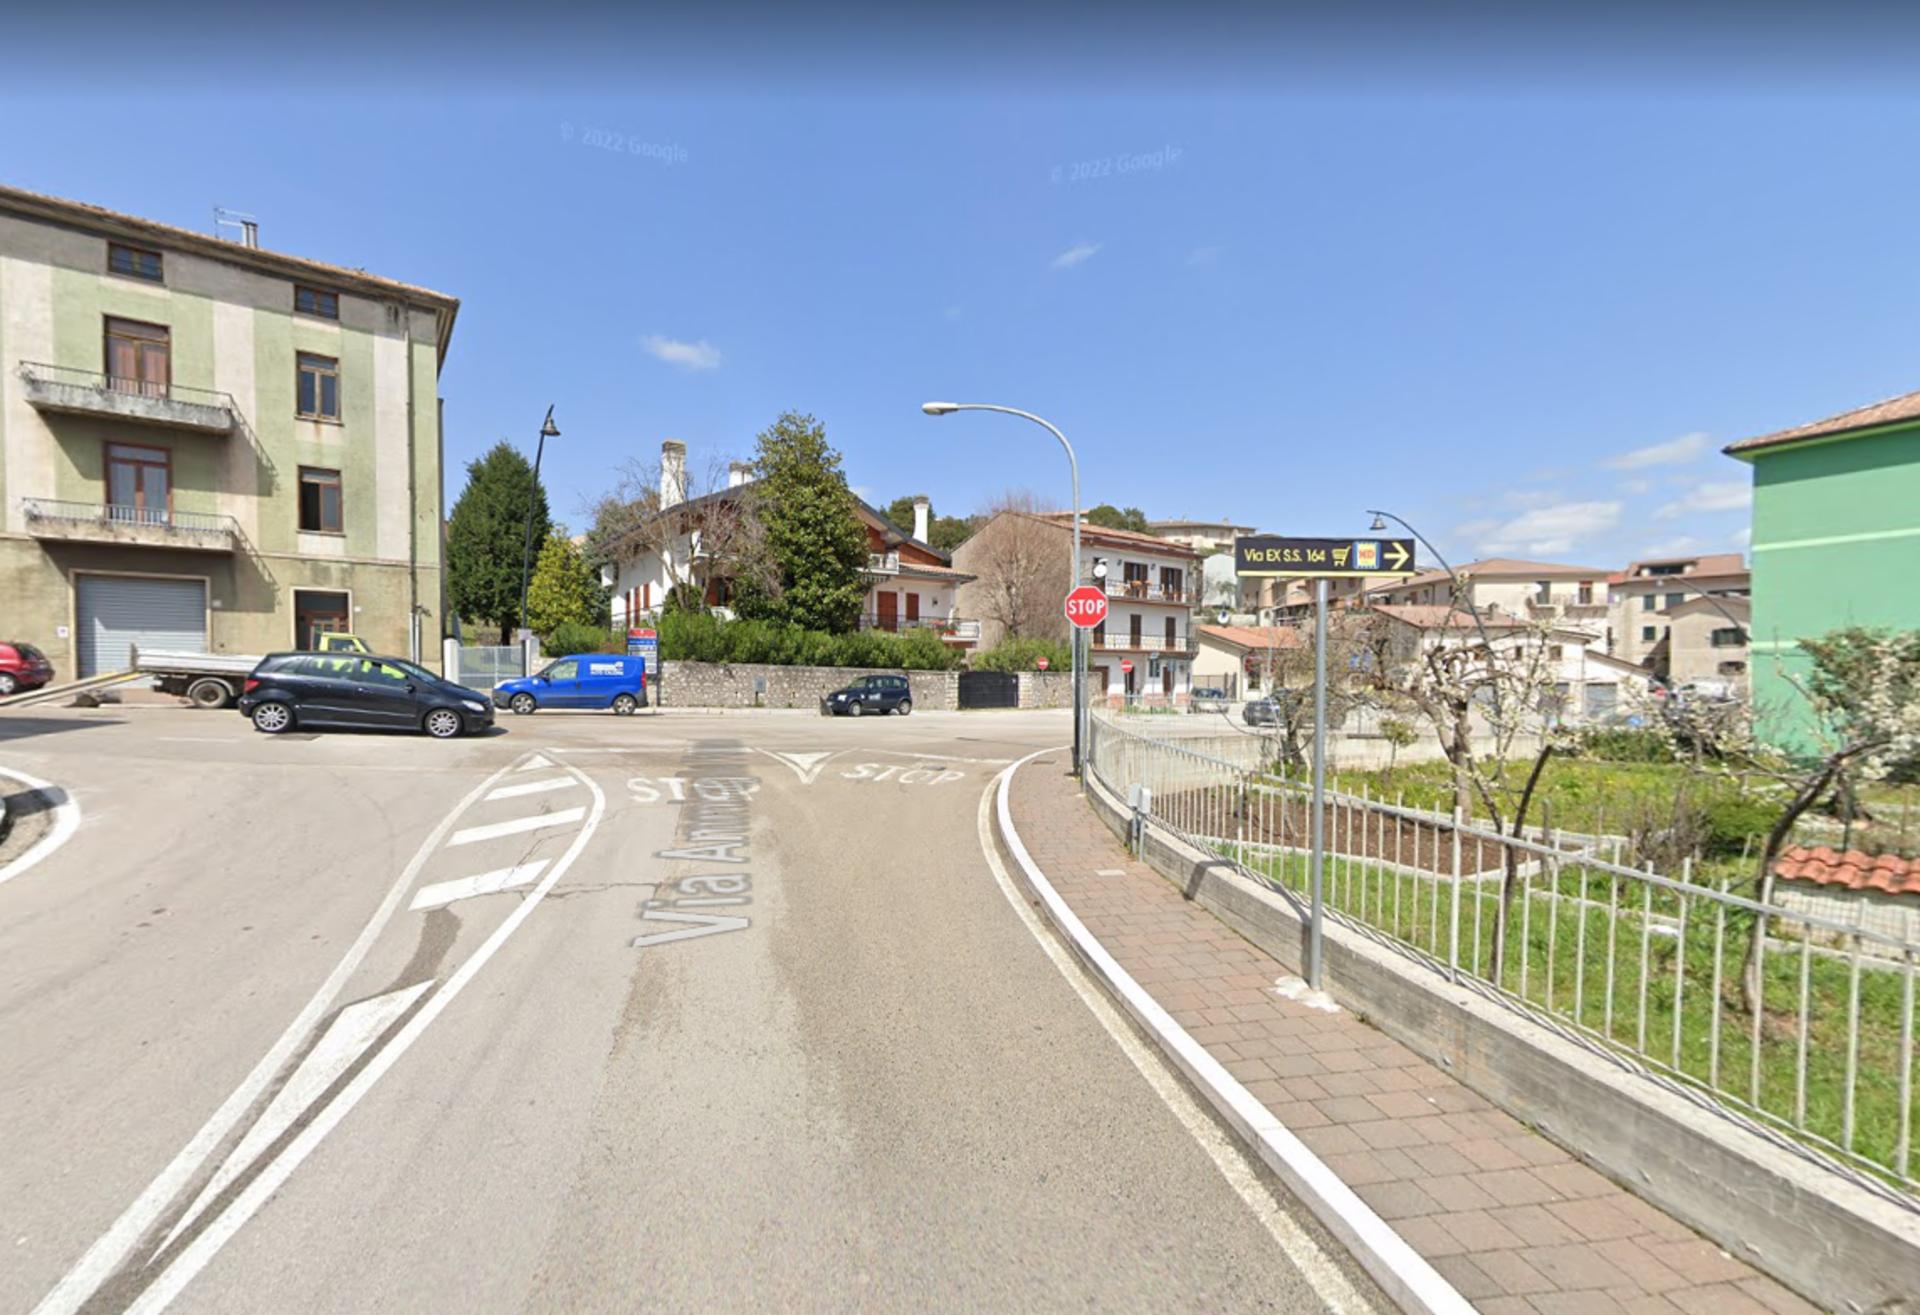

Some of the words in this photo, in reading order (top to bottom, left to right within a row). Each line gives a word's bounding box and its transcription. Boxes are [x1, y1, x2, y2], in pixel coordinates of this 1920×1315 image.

[1243, 548, 1264, 562] Via
[1265, 548, 1281, 562] EX
[1306, 548, 1327, 562] 164
[1068, 599, 1105, 615] STOP
[841, 763, 965, 785] STOP
